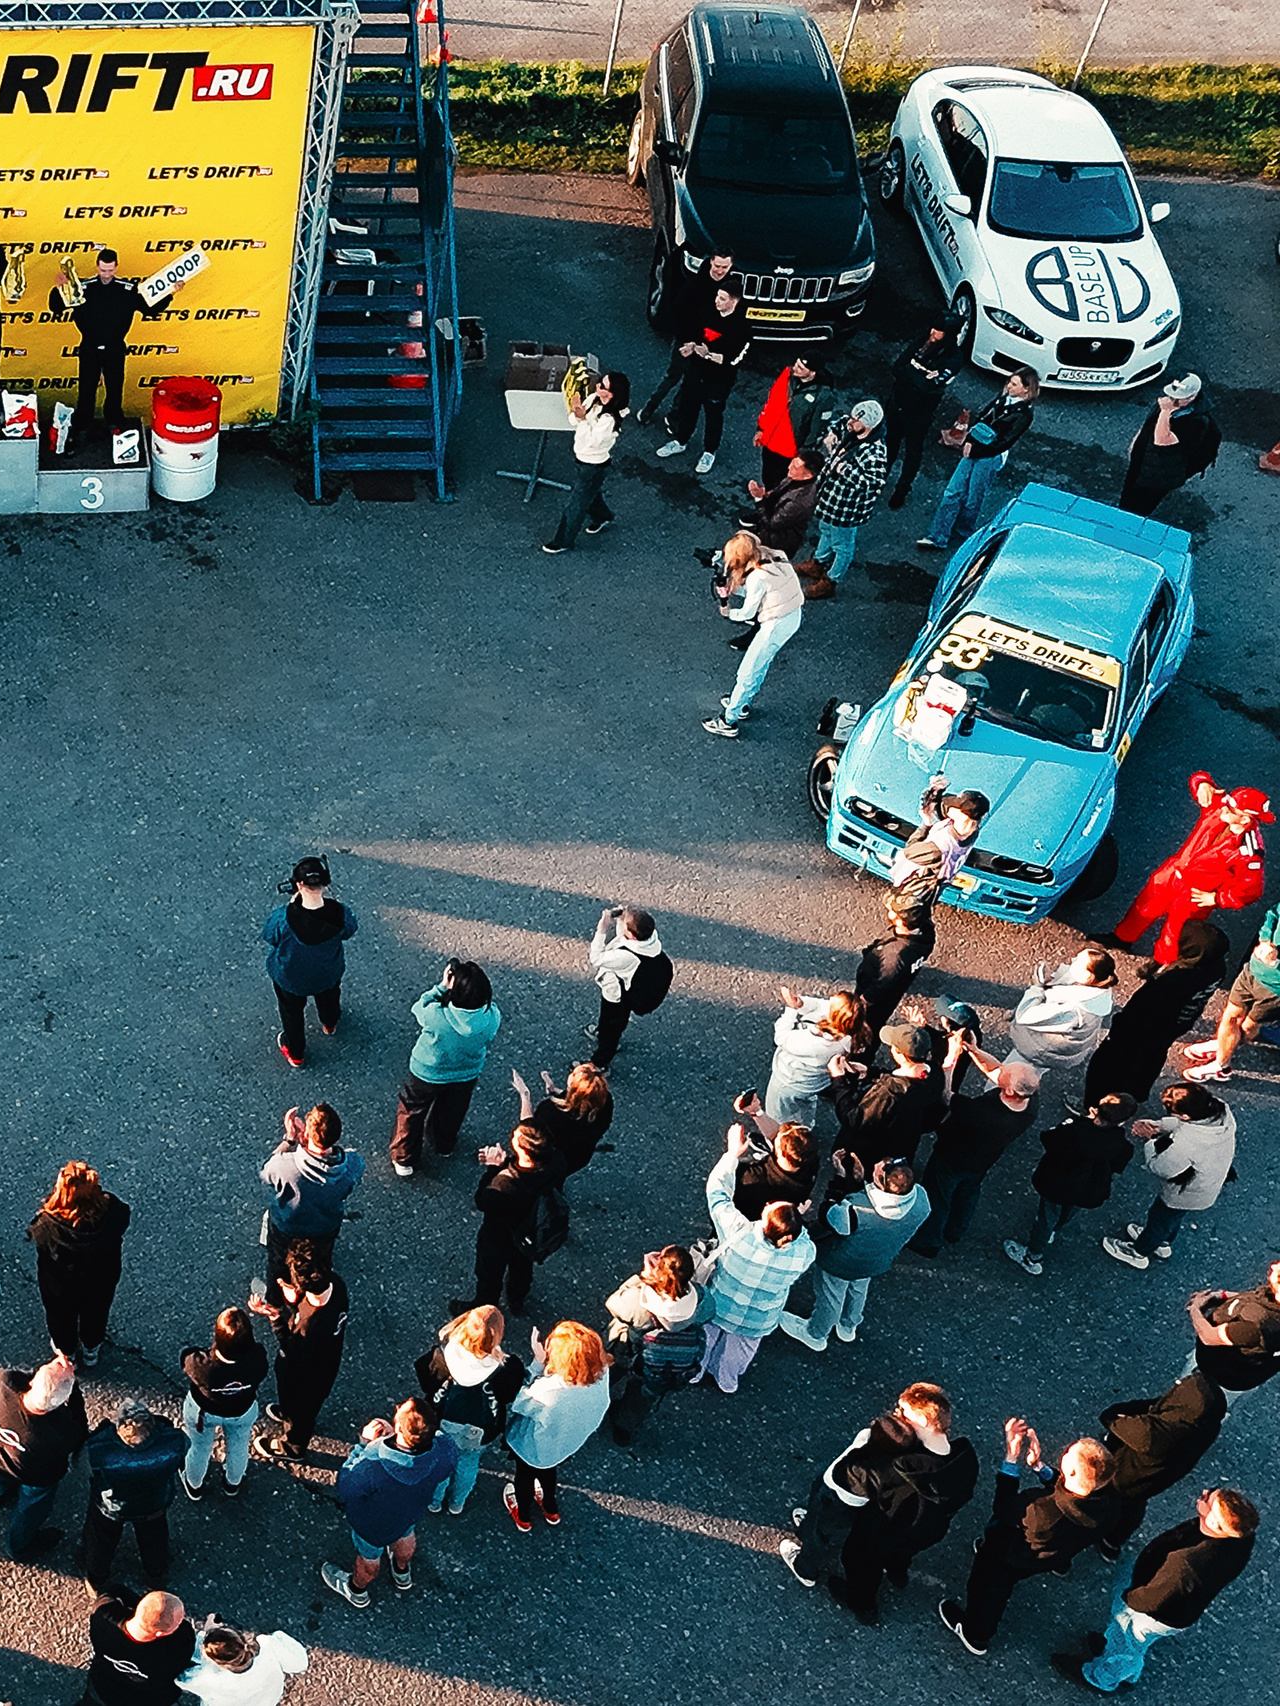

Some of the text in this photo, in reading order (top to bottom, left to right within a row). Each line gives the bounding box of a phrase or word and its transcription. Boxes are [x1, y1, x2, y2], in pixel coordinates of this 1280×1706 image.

[40, 168, 96, 181] DRIFT
[148, 167, 199, 179] LET'S
[204, 166, 259, 178] DRIFT
[64, 206, 114, 219] LET'S
[118, 205, 174, 218] DRIFT
[40, 241, 94, 254] DRIFT
[145, 240, 194, 252] LET'S
[1068, 245, 1110, 323] BASE UP
[194, 309, 247, 320] DRIFT
[80, 477, 105, 509] 3
[933, 634, 989, 671] 93
[977, 628, 1030, 651] LET'S
[1033, 645, 1091, 672] DRIFT
